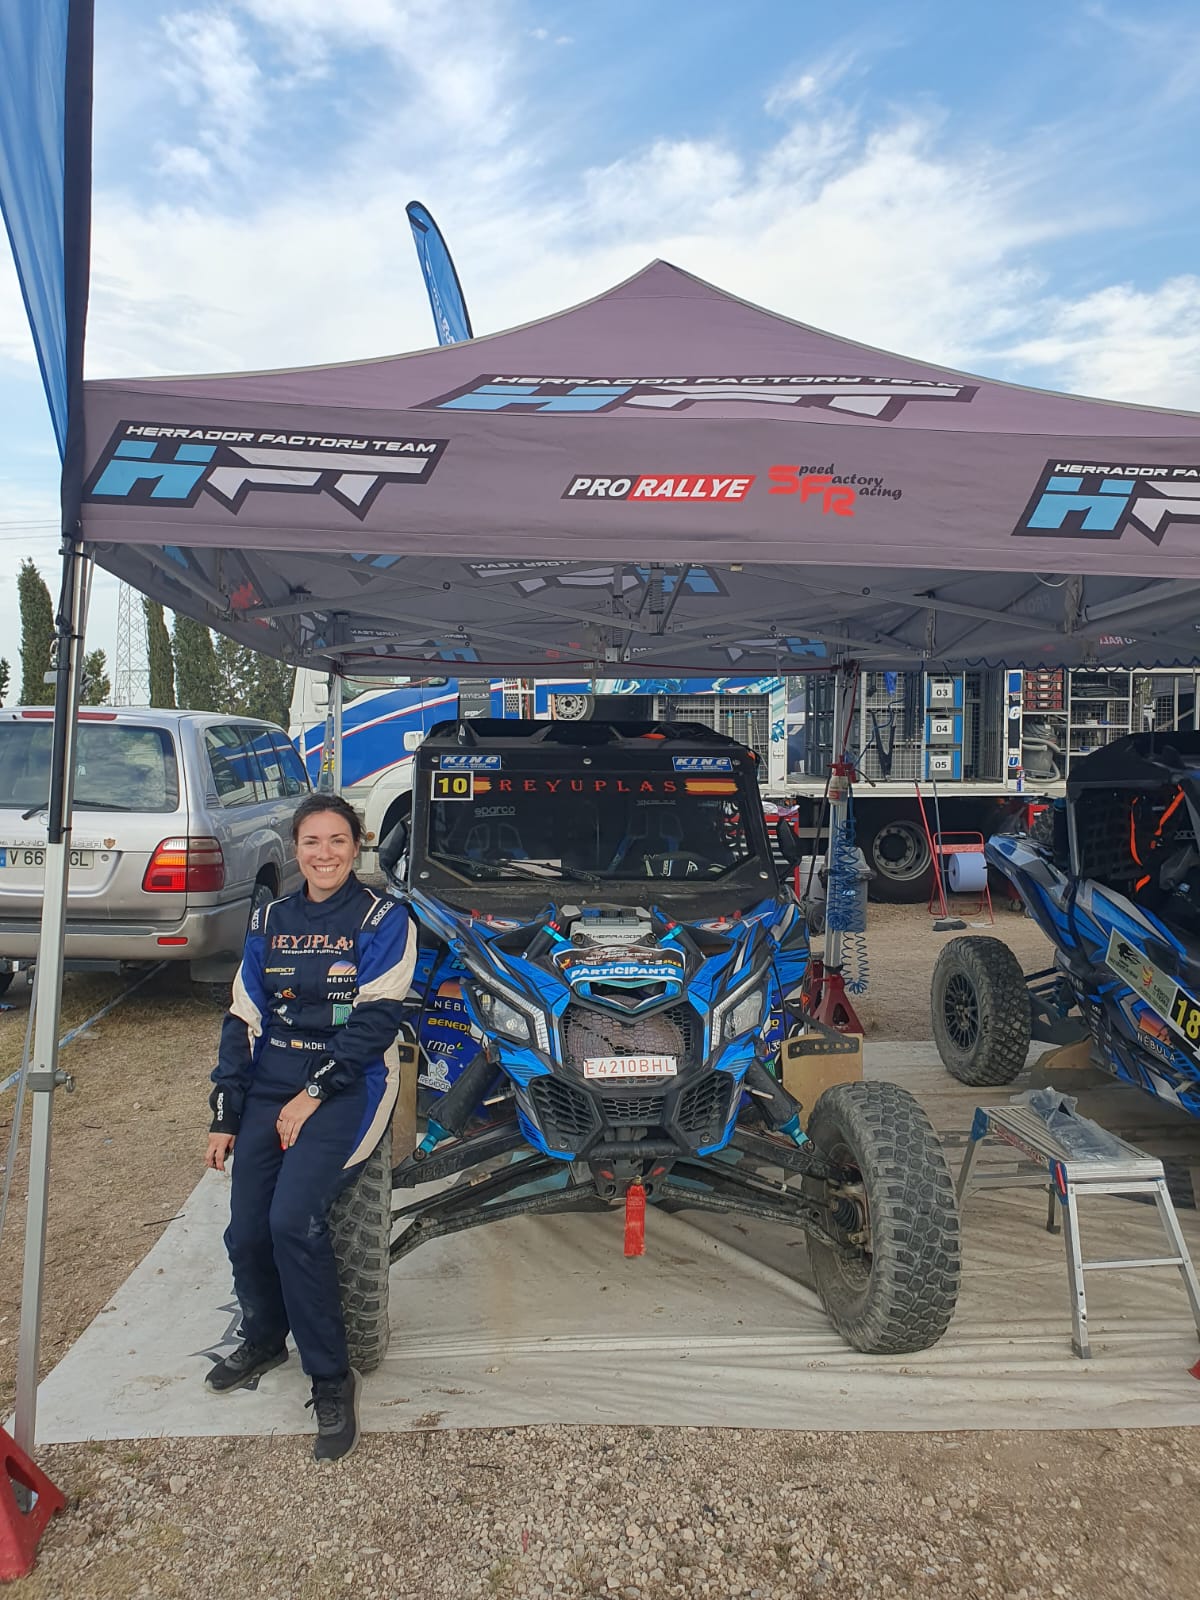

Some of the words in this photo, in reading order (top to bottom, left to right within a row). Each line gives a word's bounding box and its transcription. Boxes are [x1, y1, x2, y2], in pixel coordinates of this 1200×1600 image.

[491, 375, 687, 386] HERRADOR
[694, 375, 865, 385] FACTORY
[871, 377, 965, 389] TEAM
[125, 424, 254, 442] HERRADOR
[258, 433, 369, 450] FACTORY
[372, 440, 437, 454] TEAM
[1054, 463, 1168, 477] HERRADOR
[567, 477, 631, 497] PRO
[632, 477, 750, 499] RALLYE
[936, 689, 948, 697] 03
[936, 724, 948, 733] 04
[443, 756, 499, 764] KING
[675, 758, 730, 766] KING
[935, 760, 947, 769] 05
[438, 777, 468, 794] 10
[499, 779, 678, 793] REYUPLAS
[9, 850, 19, 865] V
[571, 966, 677, 979] PARTICIPANTE
[327, 990, 353, 1000] rme
[426, 1039, 456, 1055] rme
[1136, 1031, 1176, 1063] NÉBULA
[585, 1058, 675, 1076] E4210BHL
